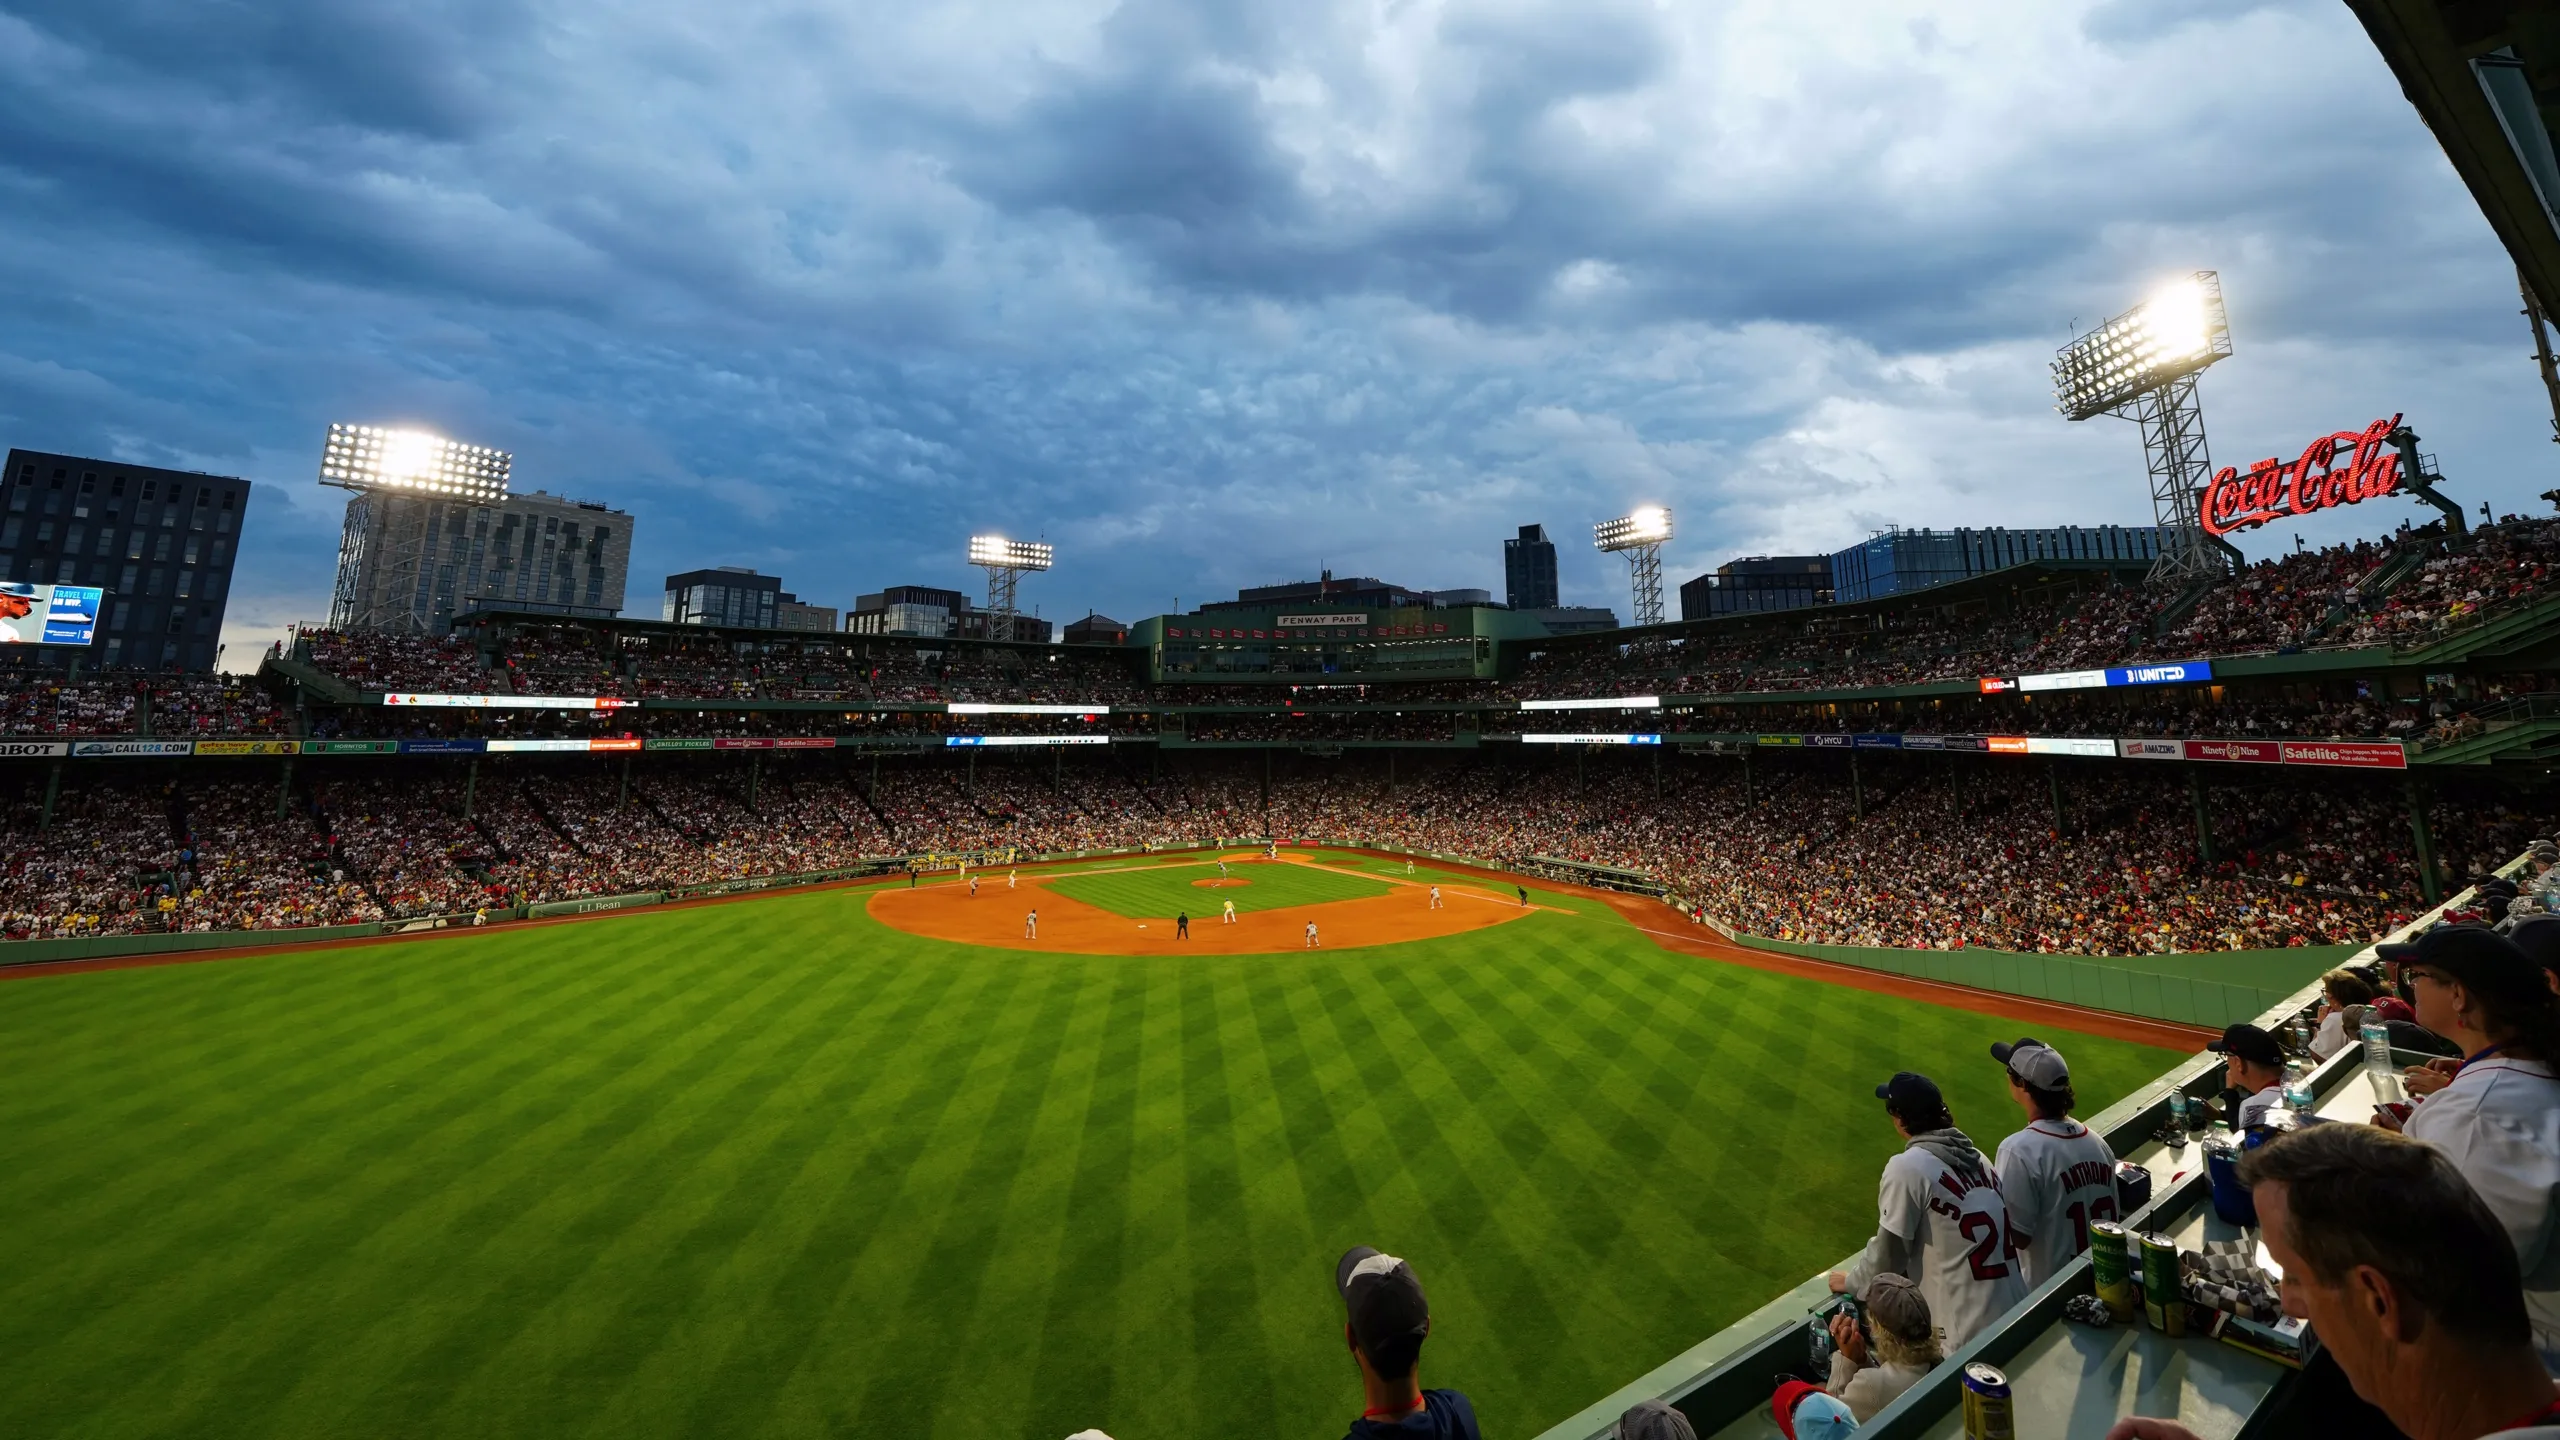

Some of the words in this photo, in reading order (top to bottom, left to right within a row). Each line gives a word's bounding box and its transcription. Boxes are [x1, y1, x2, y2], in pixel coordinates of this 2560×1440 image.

[2250, 458, 2275, 472] ENJOY
[2201, 413, 2404, 534] Coca-Cola
[54, 590, 81, 599] TRAVEL
[82, 592, 99, 600] LIKE
[1282, 616, 1327, 625] FENWAY
[1332, 615, 1362, 623] PARK
[2138, 666, 2185, 682] UNITED
[1824, 737, 1842, 745] HYCU
[115, 744, 188, 753] CALL128.COM
[2144, 744, 2176, 754] AMAZING
[2202, 746, 2226, 757] Ninety
[2240, 746, 2260, 756] Nine
[2285, 747, 2339, 760] Safelite
[578, 901, 621, 914] L.L.Bean
[2060, 1161, 2112, 1195] ANTHONY
